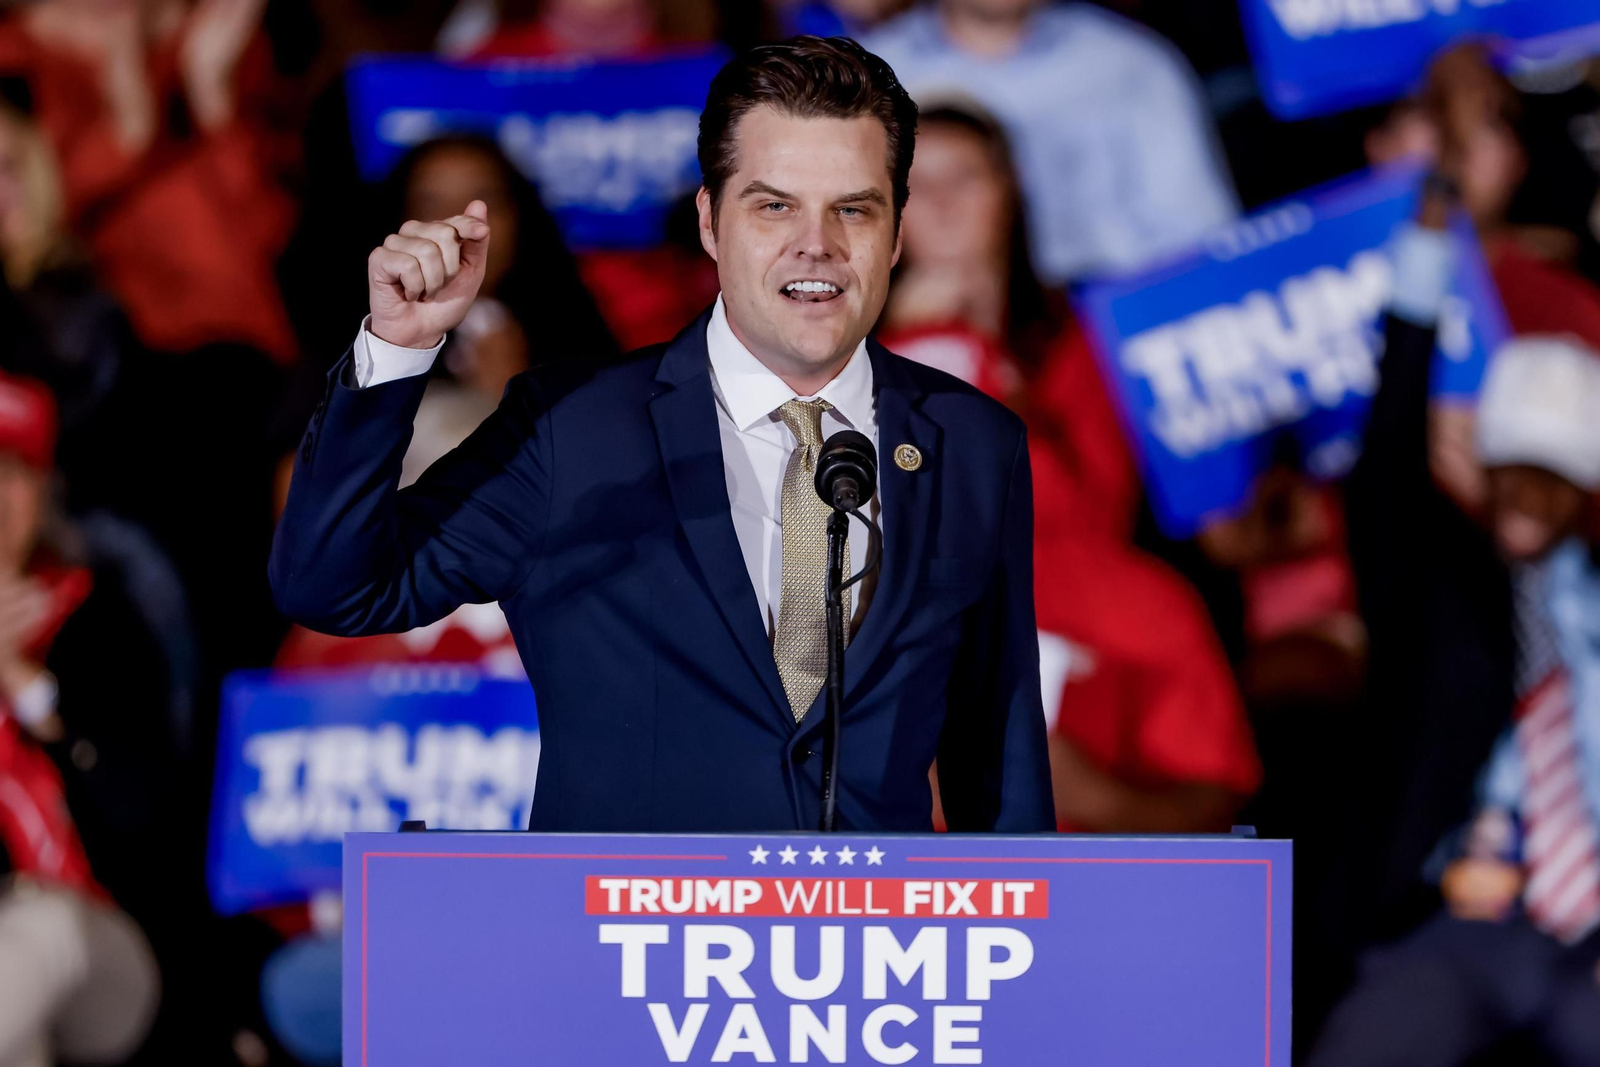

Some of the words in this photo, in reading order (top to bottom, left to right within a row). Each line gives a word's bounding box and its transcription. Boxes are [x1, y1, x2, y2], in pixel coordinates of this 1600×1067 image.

[1120, 250, 1396, 404] TRUM
[242, 721, 541, 802] TRUM
[599, 878, 763, 914] TRUMP
[775, 880, 890, 915] WILL
[903, 881, 979, 915] FIX
[991, 882, 1035, 916] IT
[599, 923, 1035, 1001] TRUMP
[647, 1002, 984, 1065] VANCE
